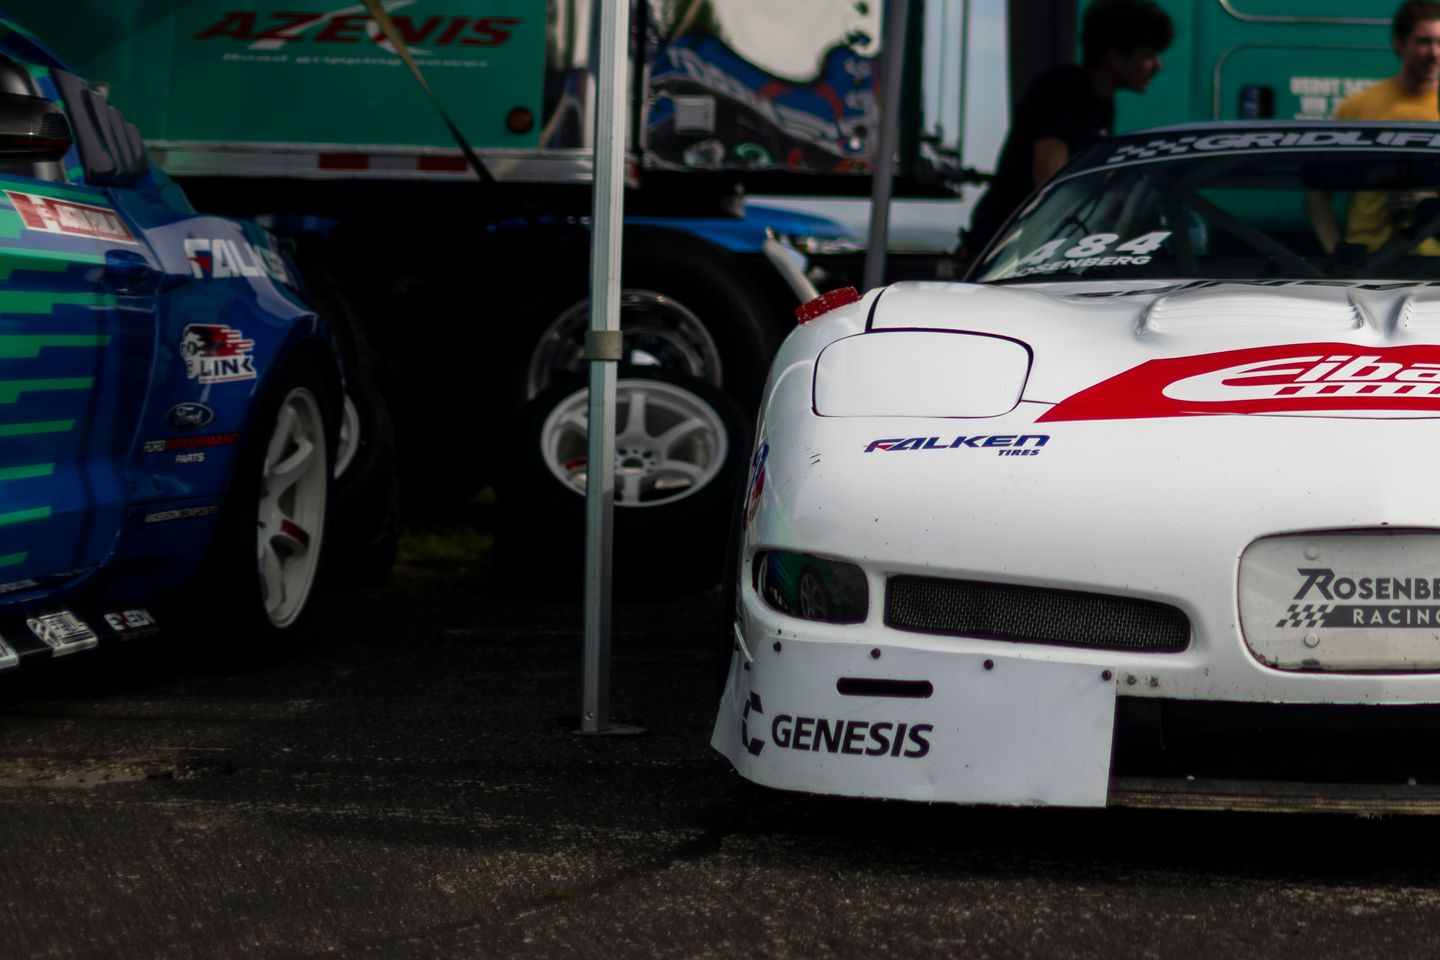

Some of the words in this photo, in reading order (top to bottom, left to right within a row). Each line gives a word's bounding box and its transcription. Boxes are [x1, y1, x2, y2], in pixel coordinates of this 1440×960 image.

[202, 11, 521, 47] AZENIS
[184, 238, 293, 284] FALKE
[1018, 231, 1173, 266] 484
[200, 356, 254, 377] LINK
[175, 452, 205, 464] PARTS
[864, 434, 1050, 453] FALKEN
[771, 714, 934, 759] GENESIS
